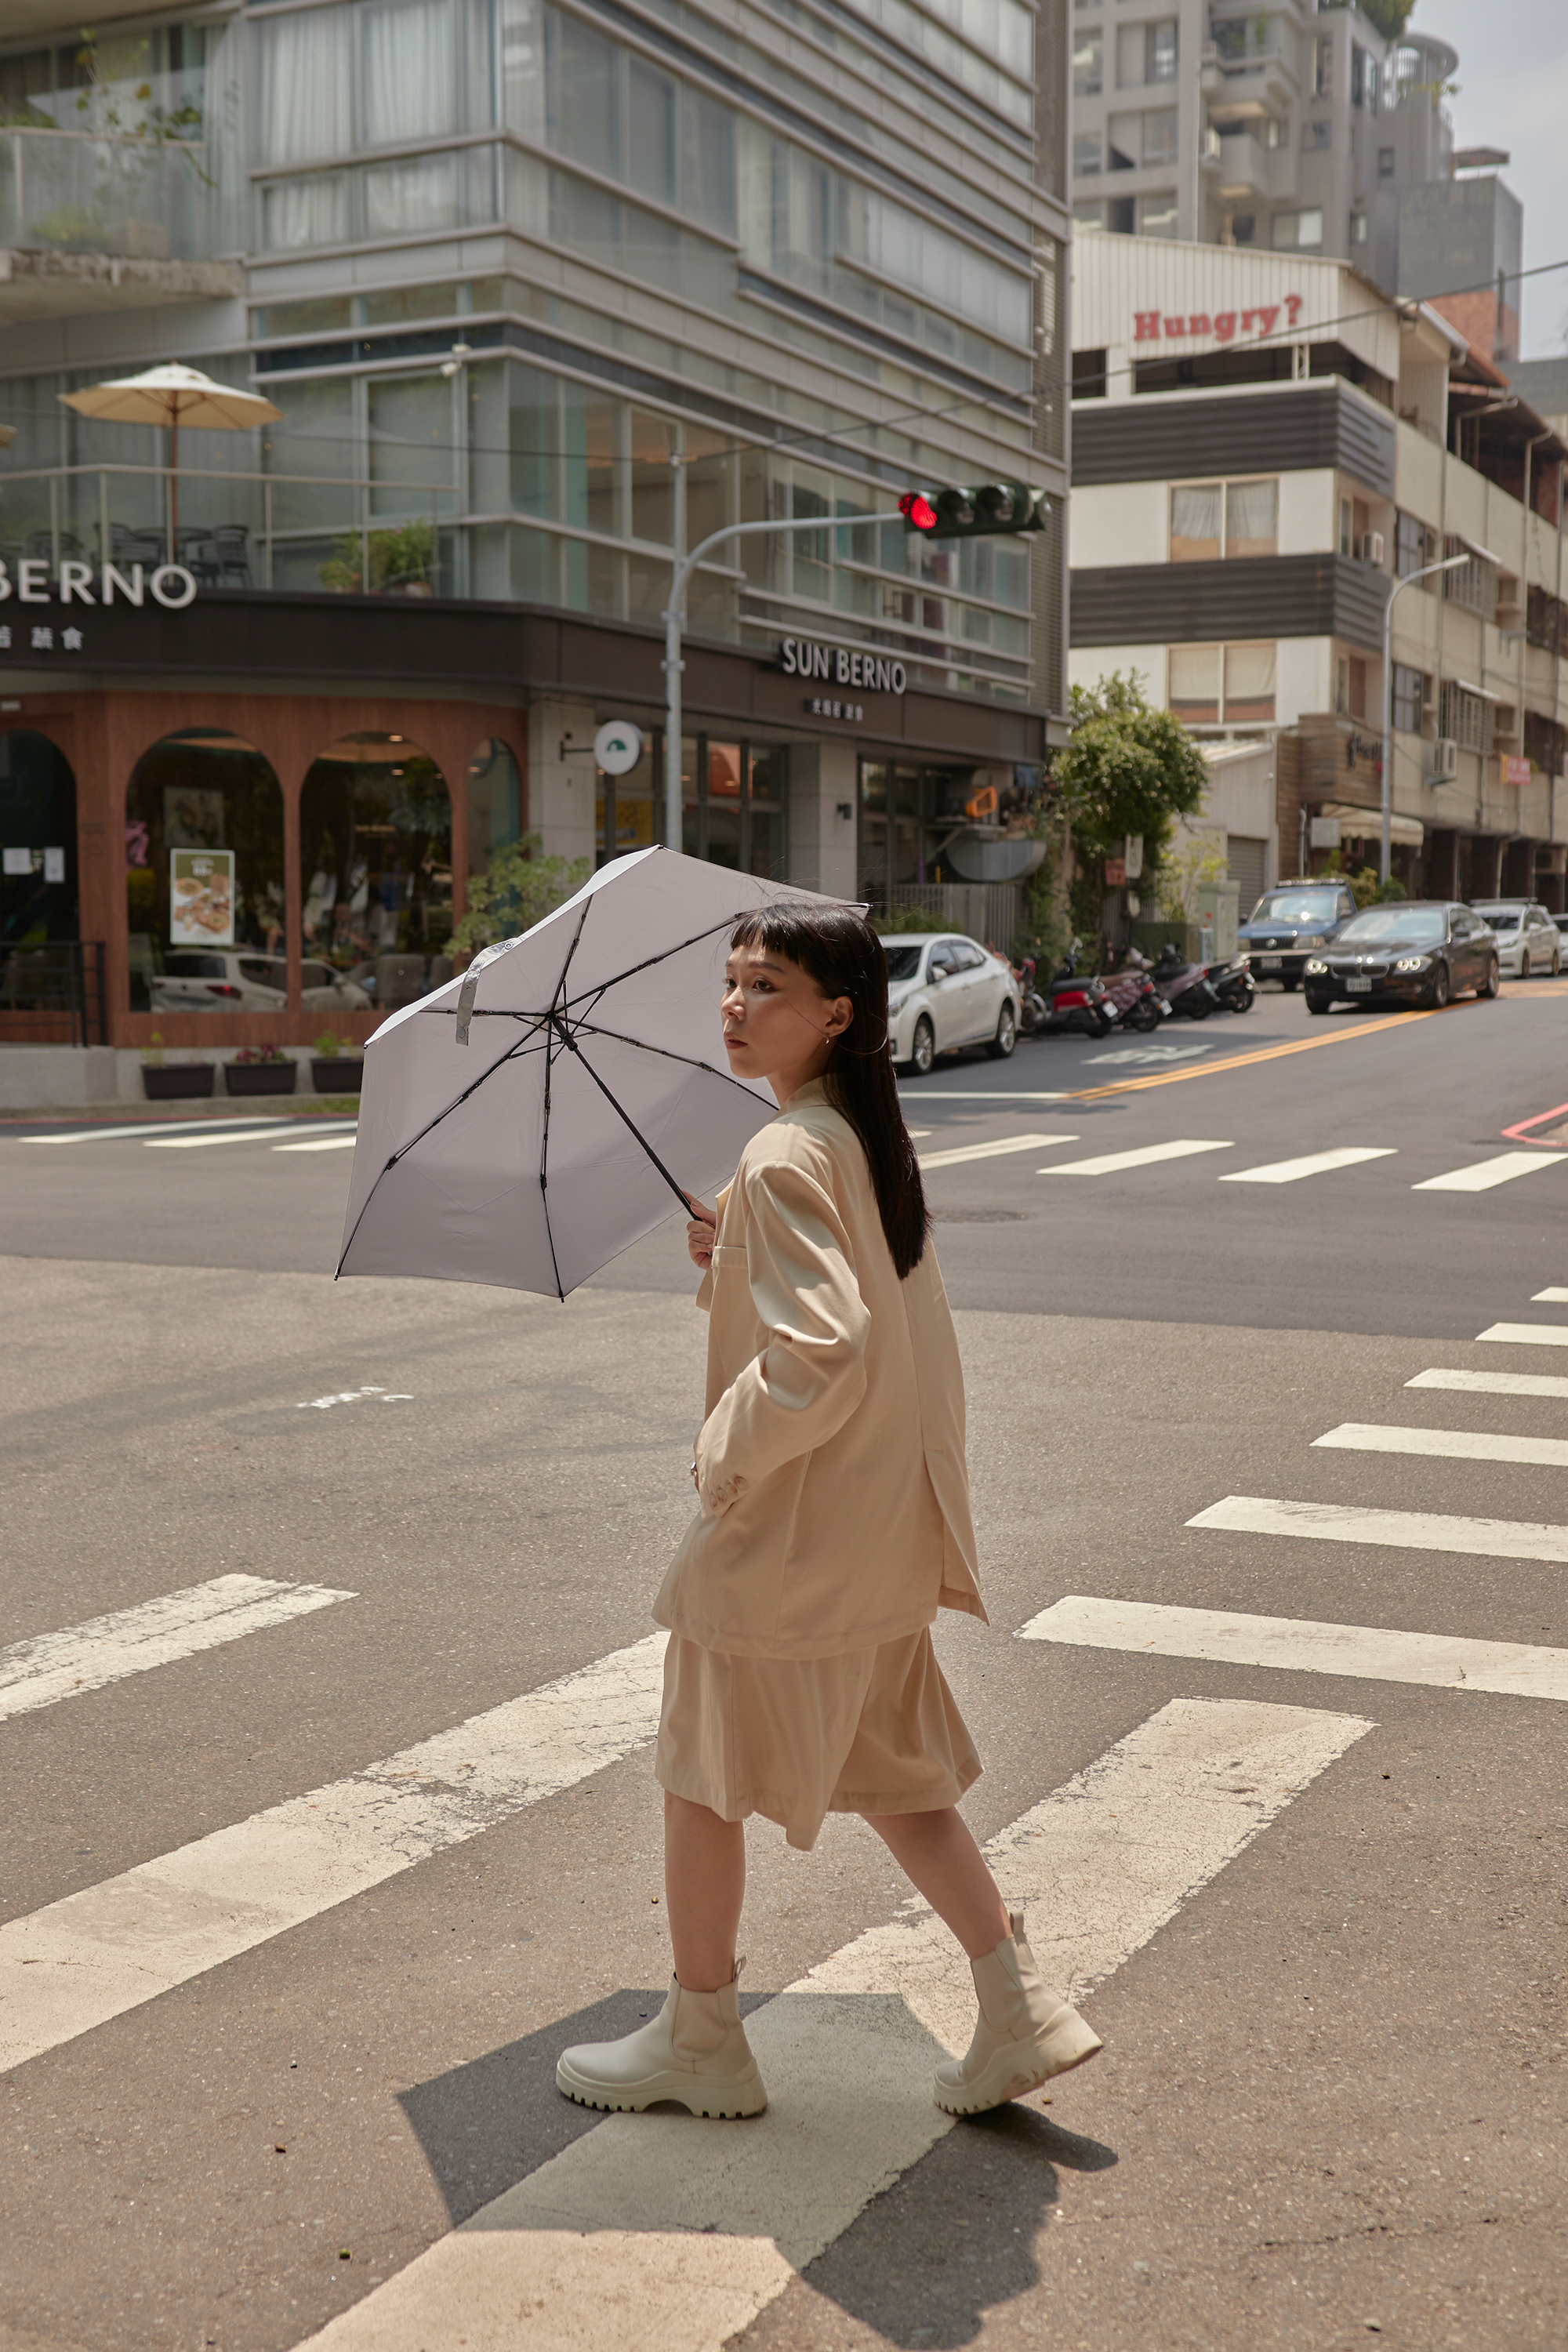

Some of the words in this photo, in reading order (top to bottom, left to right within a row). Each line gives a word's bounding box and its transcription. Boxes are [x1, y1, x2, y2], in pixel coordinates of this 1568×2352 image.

[1134, 293, 1302, 343] Hungry?
[782, 637, 829, 681] SUN
[836, 648, 906, 695] BERNO
